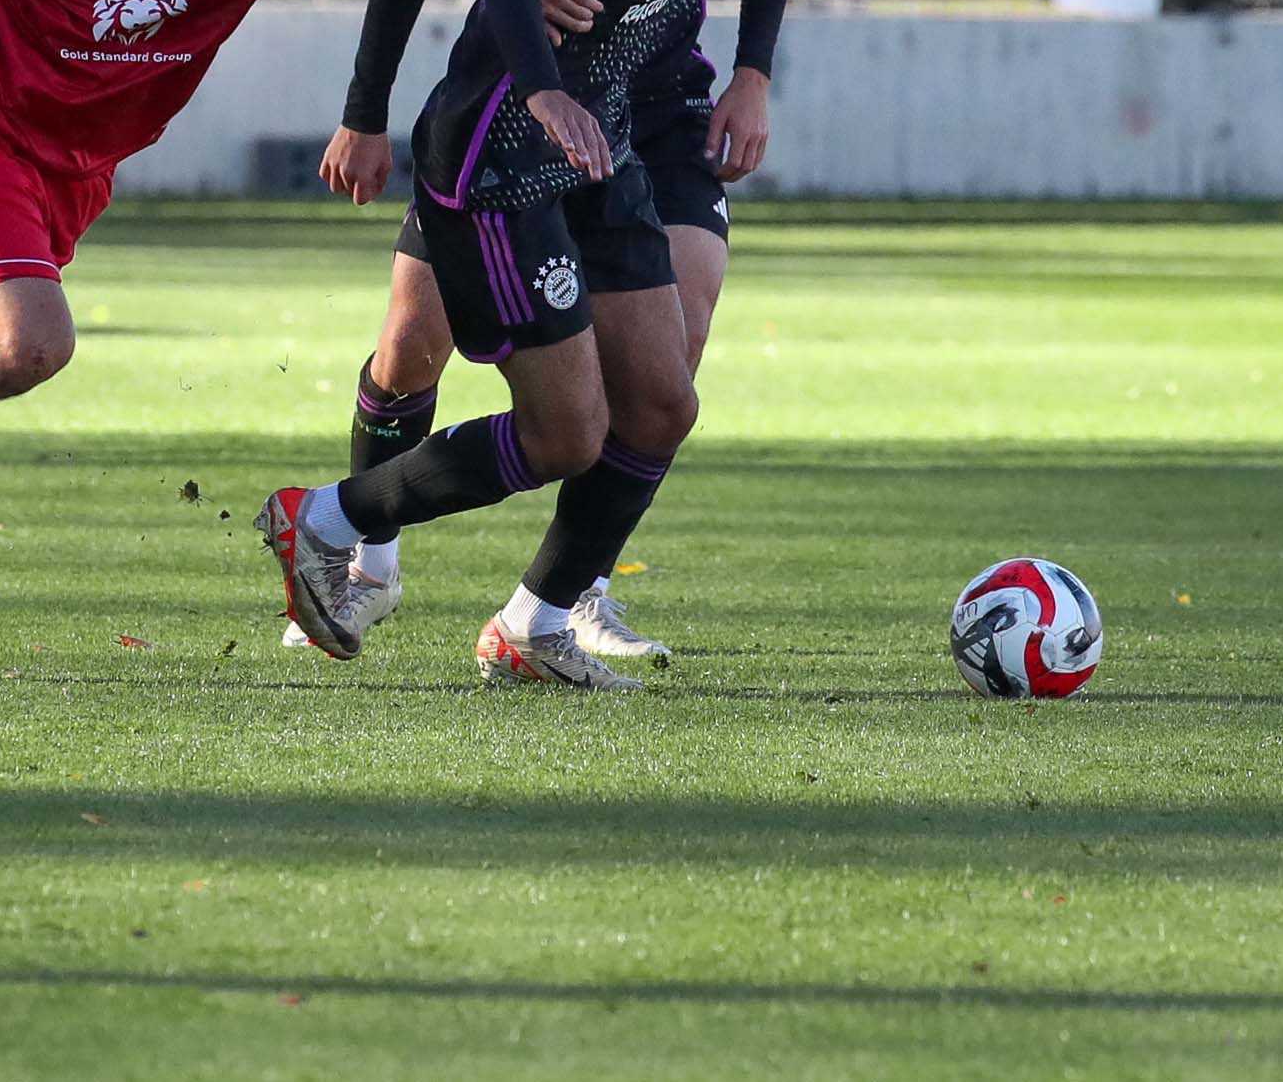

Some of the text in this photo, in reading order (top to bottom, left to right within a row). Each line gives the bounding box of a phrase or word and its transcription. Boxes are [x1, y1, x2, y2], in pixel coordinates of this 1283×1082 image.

[60, 49, 192, 63] Gold Standard Group
